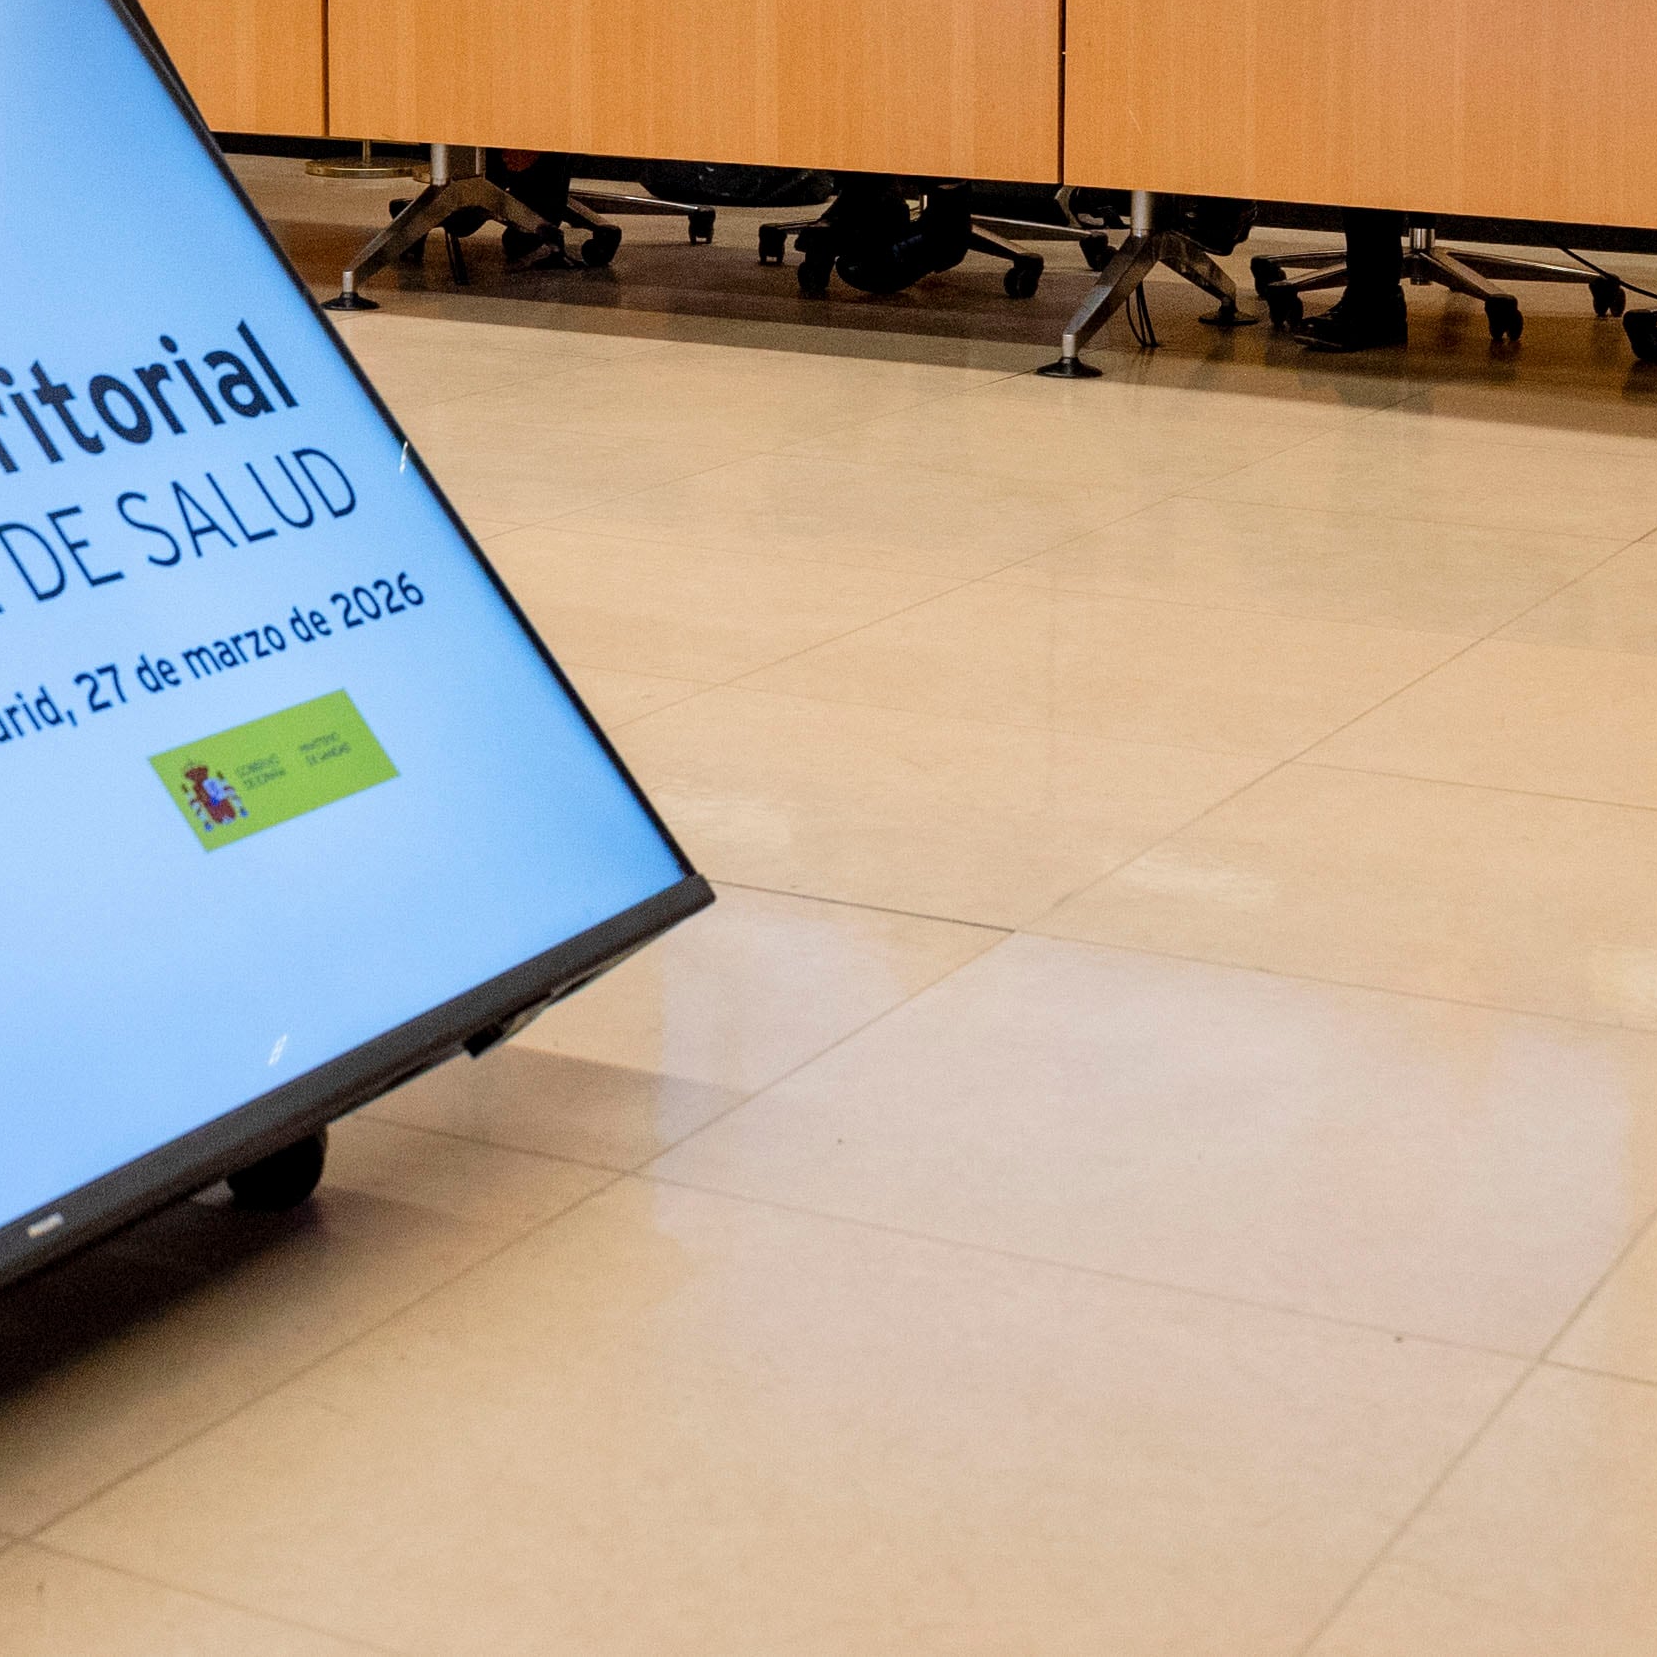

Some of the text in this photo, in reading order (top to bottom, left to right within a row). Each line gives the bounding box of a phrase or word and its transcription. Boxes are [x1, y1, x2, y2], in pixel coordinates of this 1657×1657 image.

[116, 446, 358, 568] SALUD
[73, 663, 129, 714] 27
[135, 653, 183, 694] de
[180, 623, 288, 683] marzo
[288, 605, 334, 644] de
[328, 570, 426, 631] 2026
